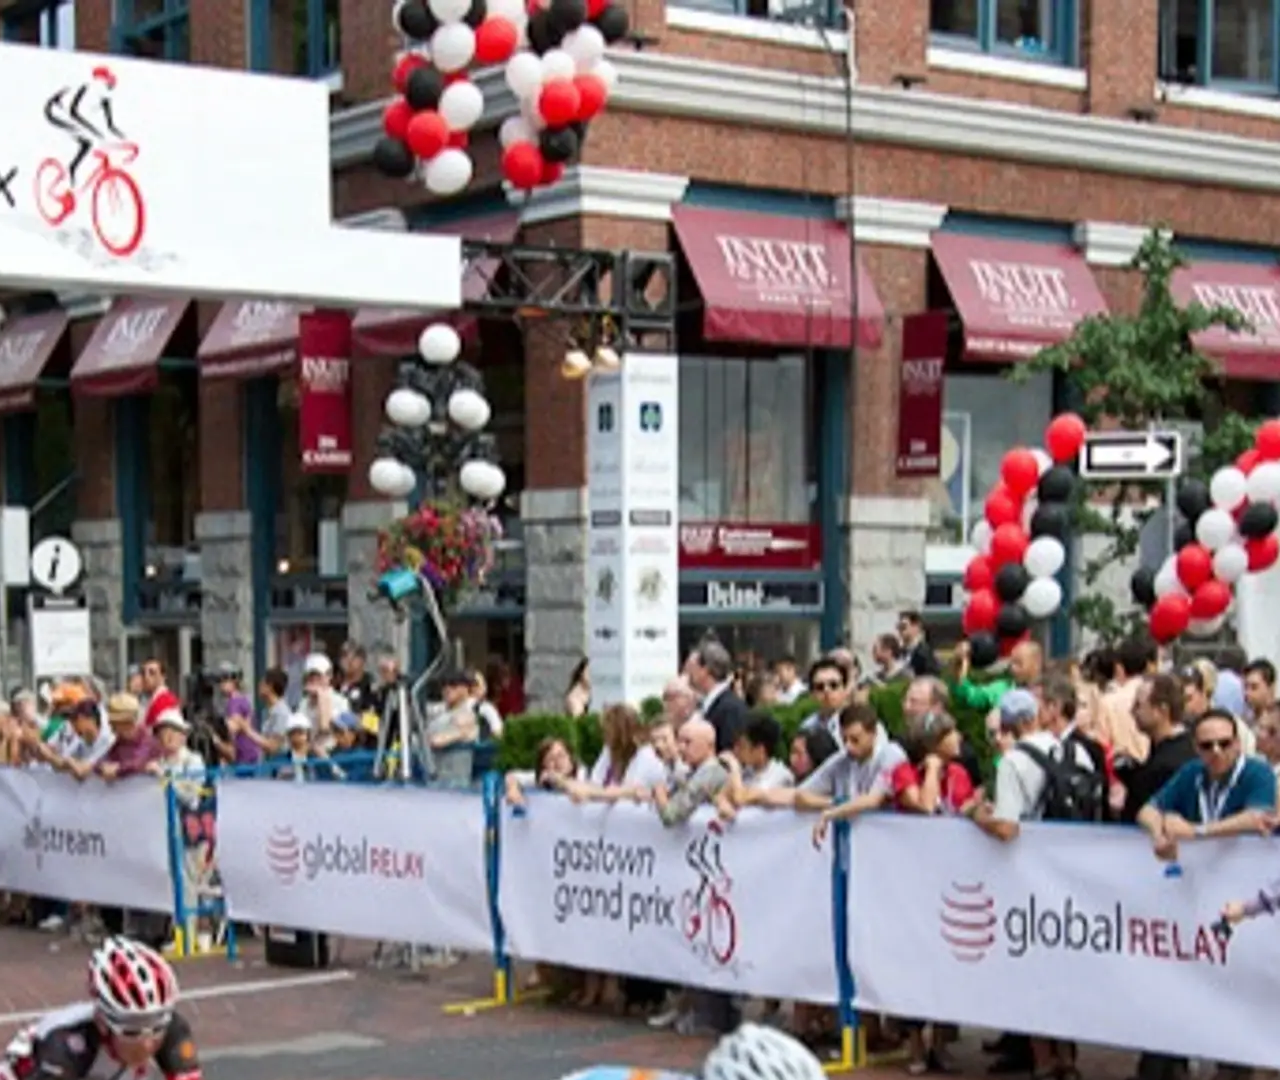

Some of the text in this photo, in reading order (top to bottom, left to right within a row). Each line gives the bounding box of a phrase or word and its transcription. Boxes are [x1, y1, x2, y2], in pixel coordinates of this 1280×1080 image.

[716, 235, 830, 285] INUIT
[969, 260, 1066, 311] INUIT
[553, 836, 655, 880] gastown
[554, 880, 676, 934] grand prix
